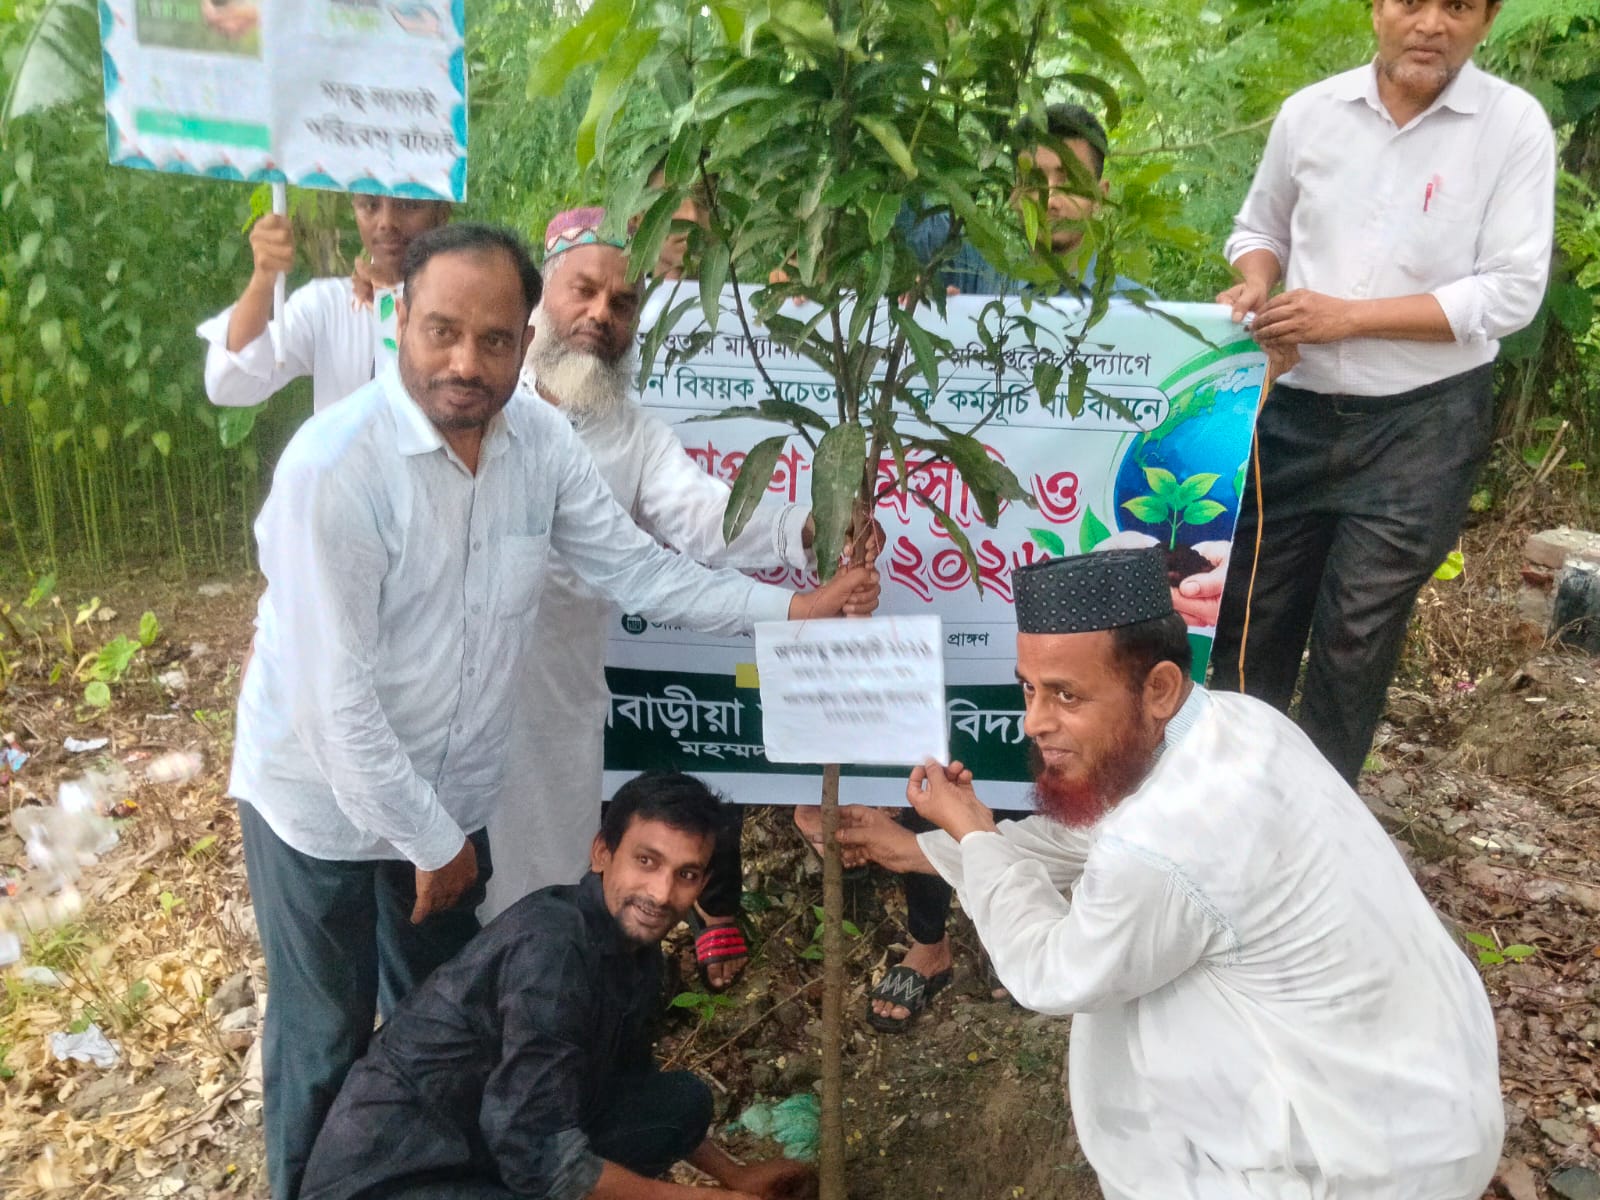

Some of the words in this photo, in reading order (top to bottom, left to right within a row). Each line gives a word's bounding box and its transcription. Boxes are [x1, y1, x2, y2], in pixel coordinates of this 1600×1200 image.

[675, 366, 755, 400] বিষয়ক
[1030, 471, 1083, 525] ও
[947, 631, 990, 648] প্রাঙ্গণ
